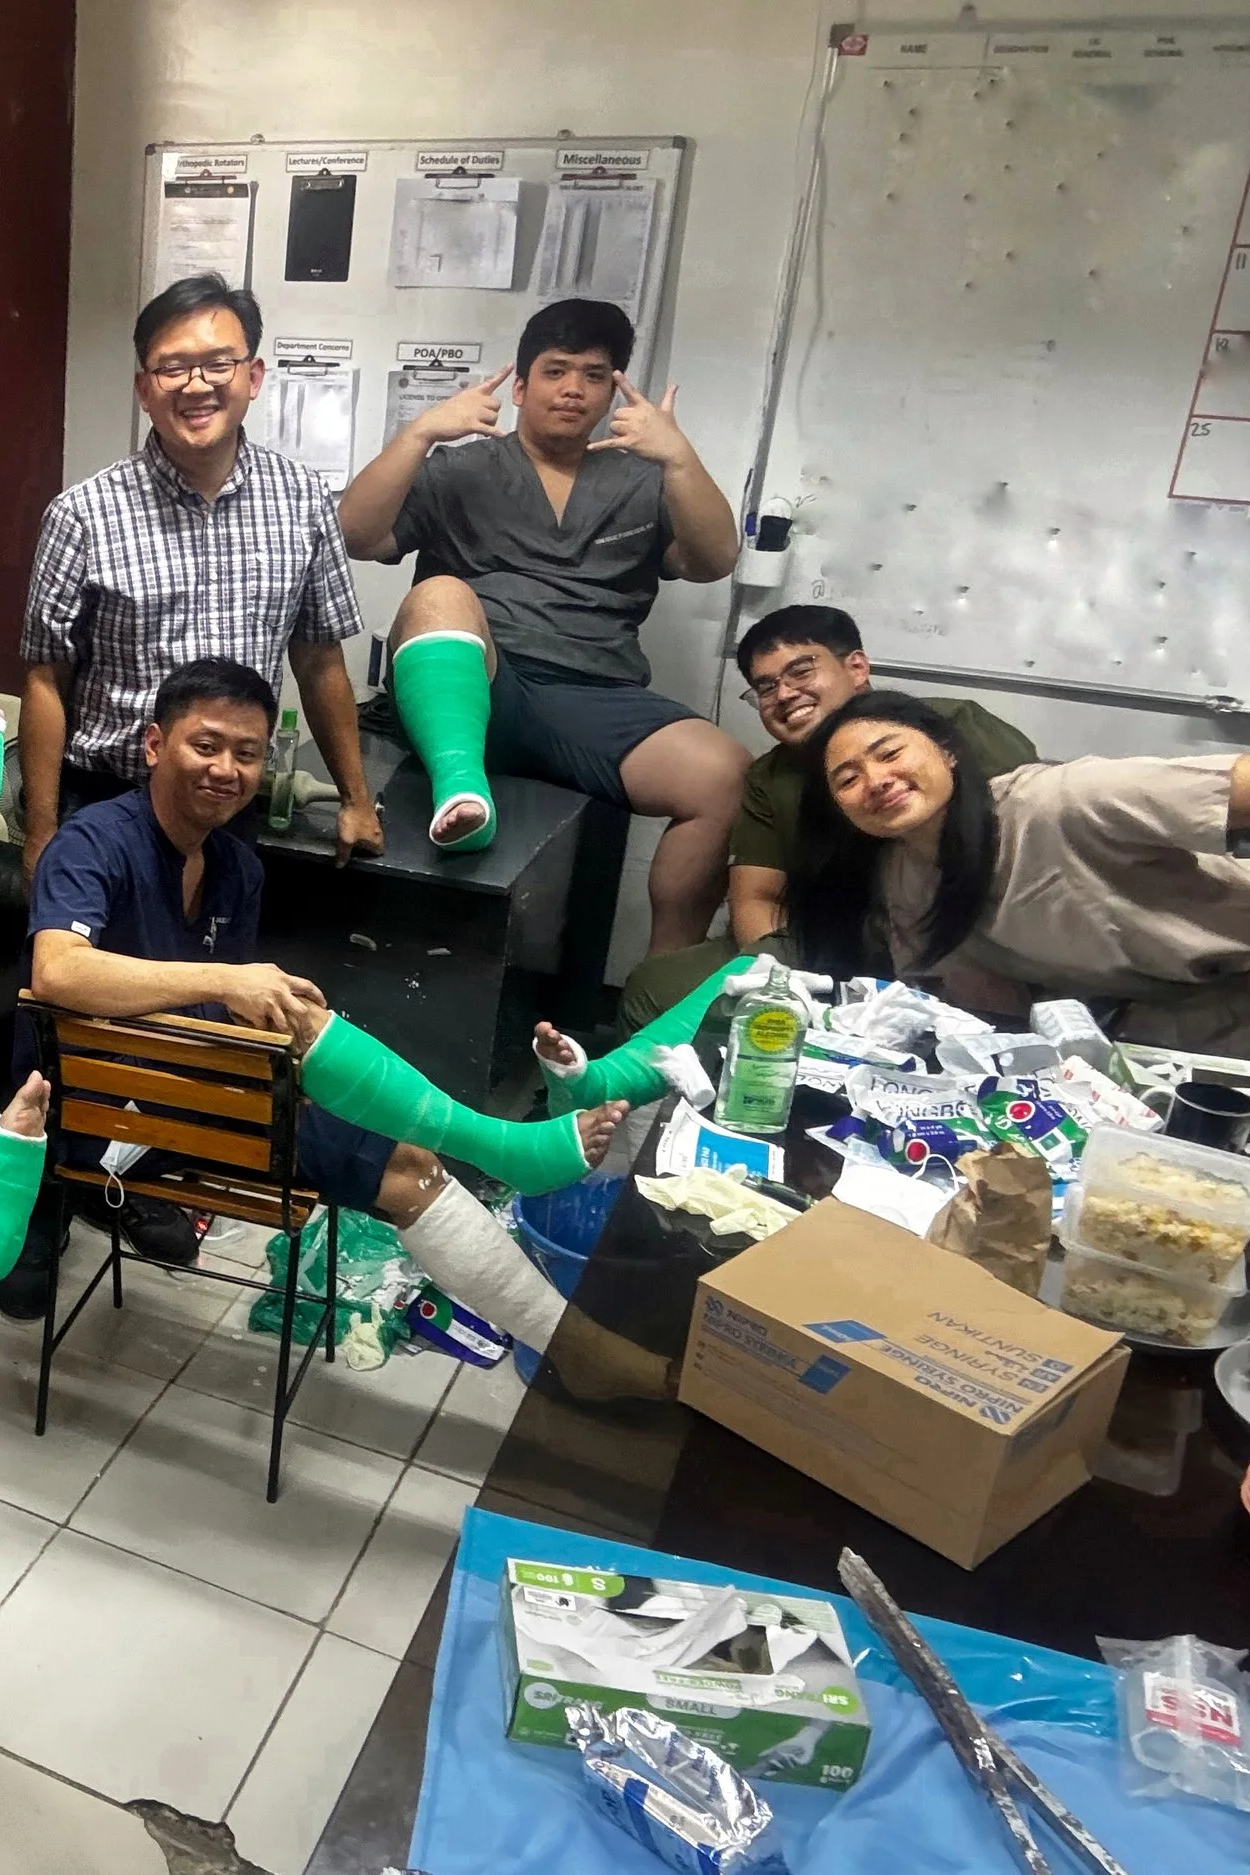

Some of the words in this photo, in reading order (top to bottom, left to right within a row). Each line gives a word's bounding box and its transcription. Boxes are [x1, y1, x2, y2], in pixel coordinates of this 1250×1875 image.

[177, 158, 213, 169] rthopedic
[214, 158, 245, 168] Rotators
[288, 156, 365, 166] Lectures/Conference
[419, 155, 459, 165] Schedule
[460, 155, 470, 165] of
[471, 156, 500, 165] Duties
[562, 154, 642, 165] Miscellaneous
[277, 341, 317, 351] Department
[318, 343, 350, 351] Concerns
[413, 347, 464, 359] POA/PBO
[1190, 422, 1212, 437] 25
[926, 1311, 1043, 1364] SUNTIKAN
[913, 1334, 1019, 1382] SYRINGE
[879, 1344, 956, 1387] SYRINGE
[913, 1375, 978, 1408] NIPRO
[962, 1384, 1024, 1414] NIPRO
[536, 1572, 560, 1584] 100
[590, 1577, 606, 1591] S
[664, 1698, 718, 1716] SMALL
[822, 1764, 854, 1779] 100
